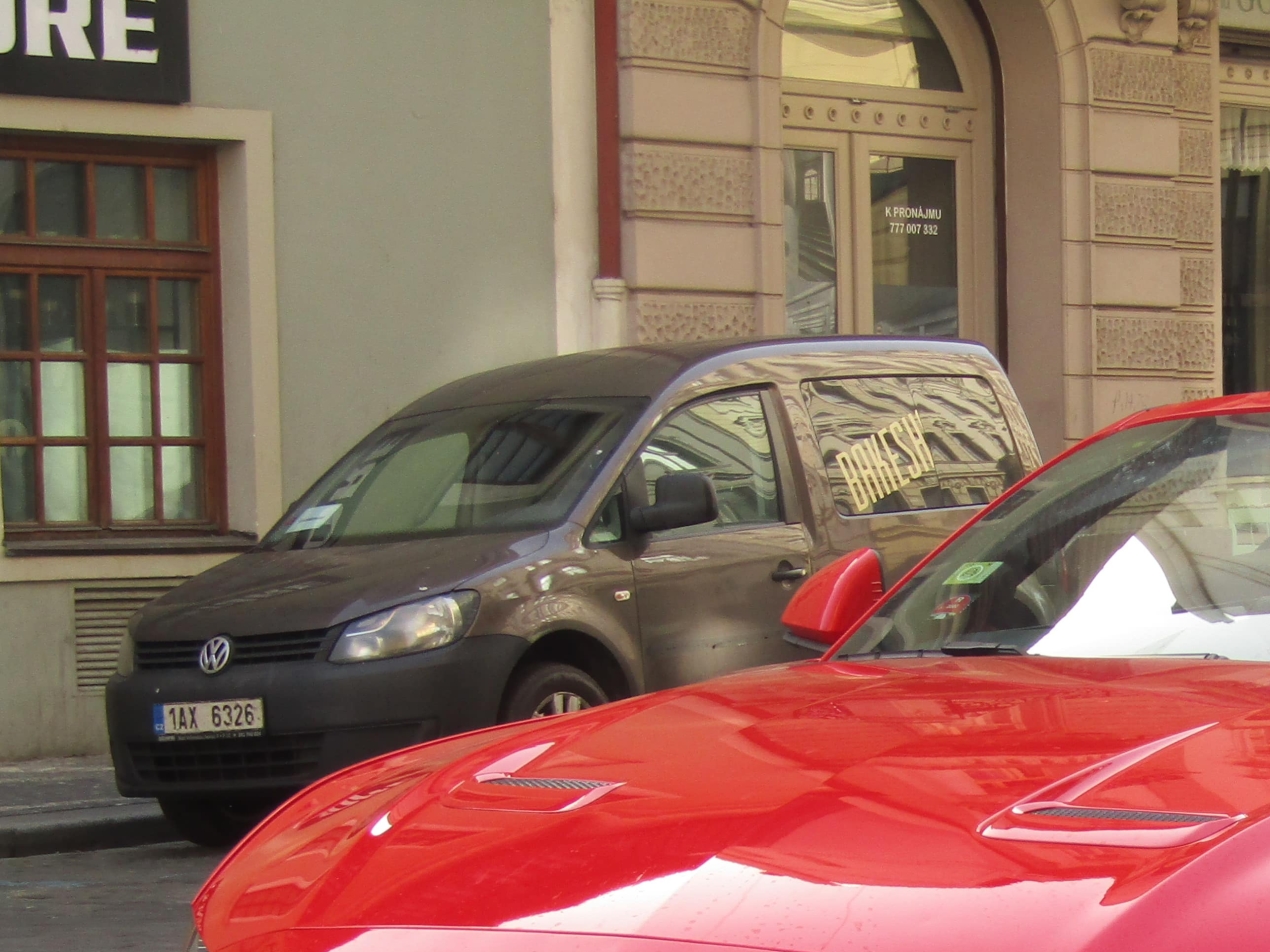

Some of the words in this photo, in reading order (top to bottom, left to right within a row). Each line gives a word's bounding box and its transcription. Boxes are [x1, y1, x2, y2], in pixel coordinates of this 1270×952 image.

[0, 0, 159, 64] RE
[885, 206, 892, 218] K
[893, 205, 942, 220] PRONÁJMU
[889, 222, 905, 234] 777
[906, 223, 921, 235] 007
[923, 224, 938, 236] 332
[169, 706, 198, 730] 1AX
[211, 703, 255, 728] 6326
